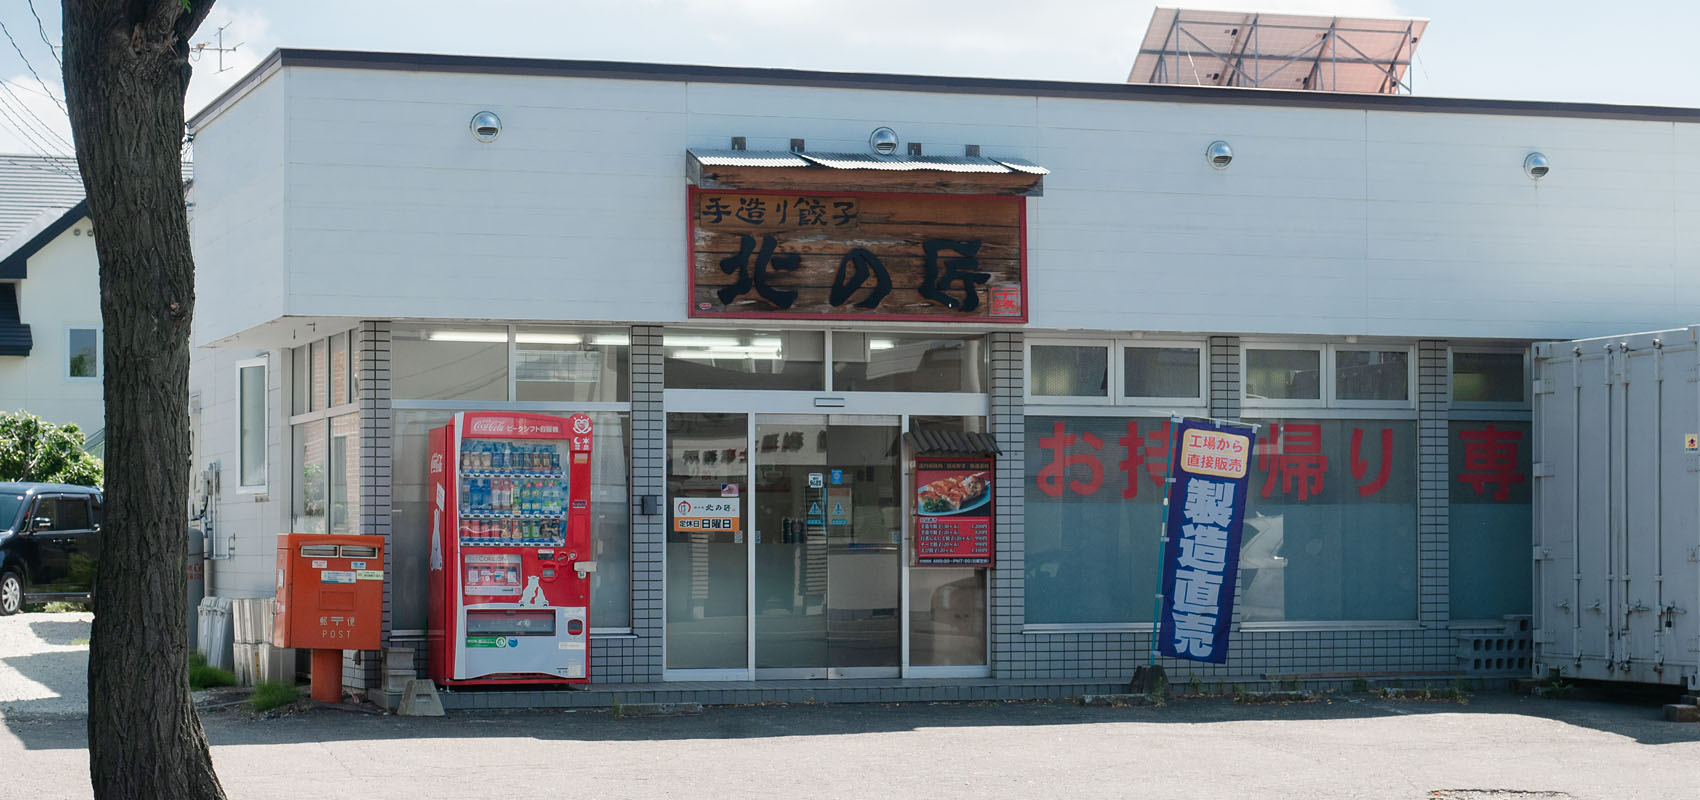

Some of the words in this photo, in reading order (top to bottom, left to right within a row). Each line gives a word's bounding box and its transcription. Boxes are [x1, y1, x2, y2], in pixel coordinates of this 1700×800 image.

[702, 197, 857, 226] 手造り餃子
[717, 234, 991, 312] 北の匠
[1188, 433, 1243, 454] 工場から
[1186, 453, 1242, 473] 直接販売
[679, 519, 700, 528] 定休日
[701, 518, 732, 529] 日曜日
[1172, 477, 1236, 658] 製造直売
[322, 630, 351, 639] POST
